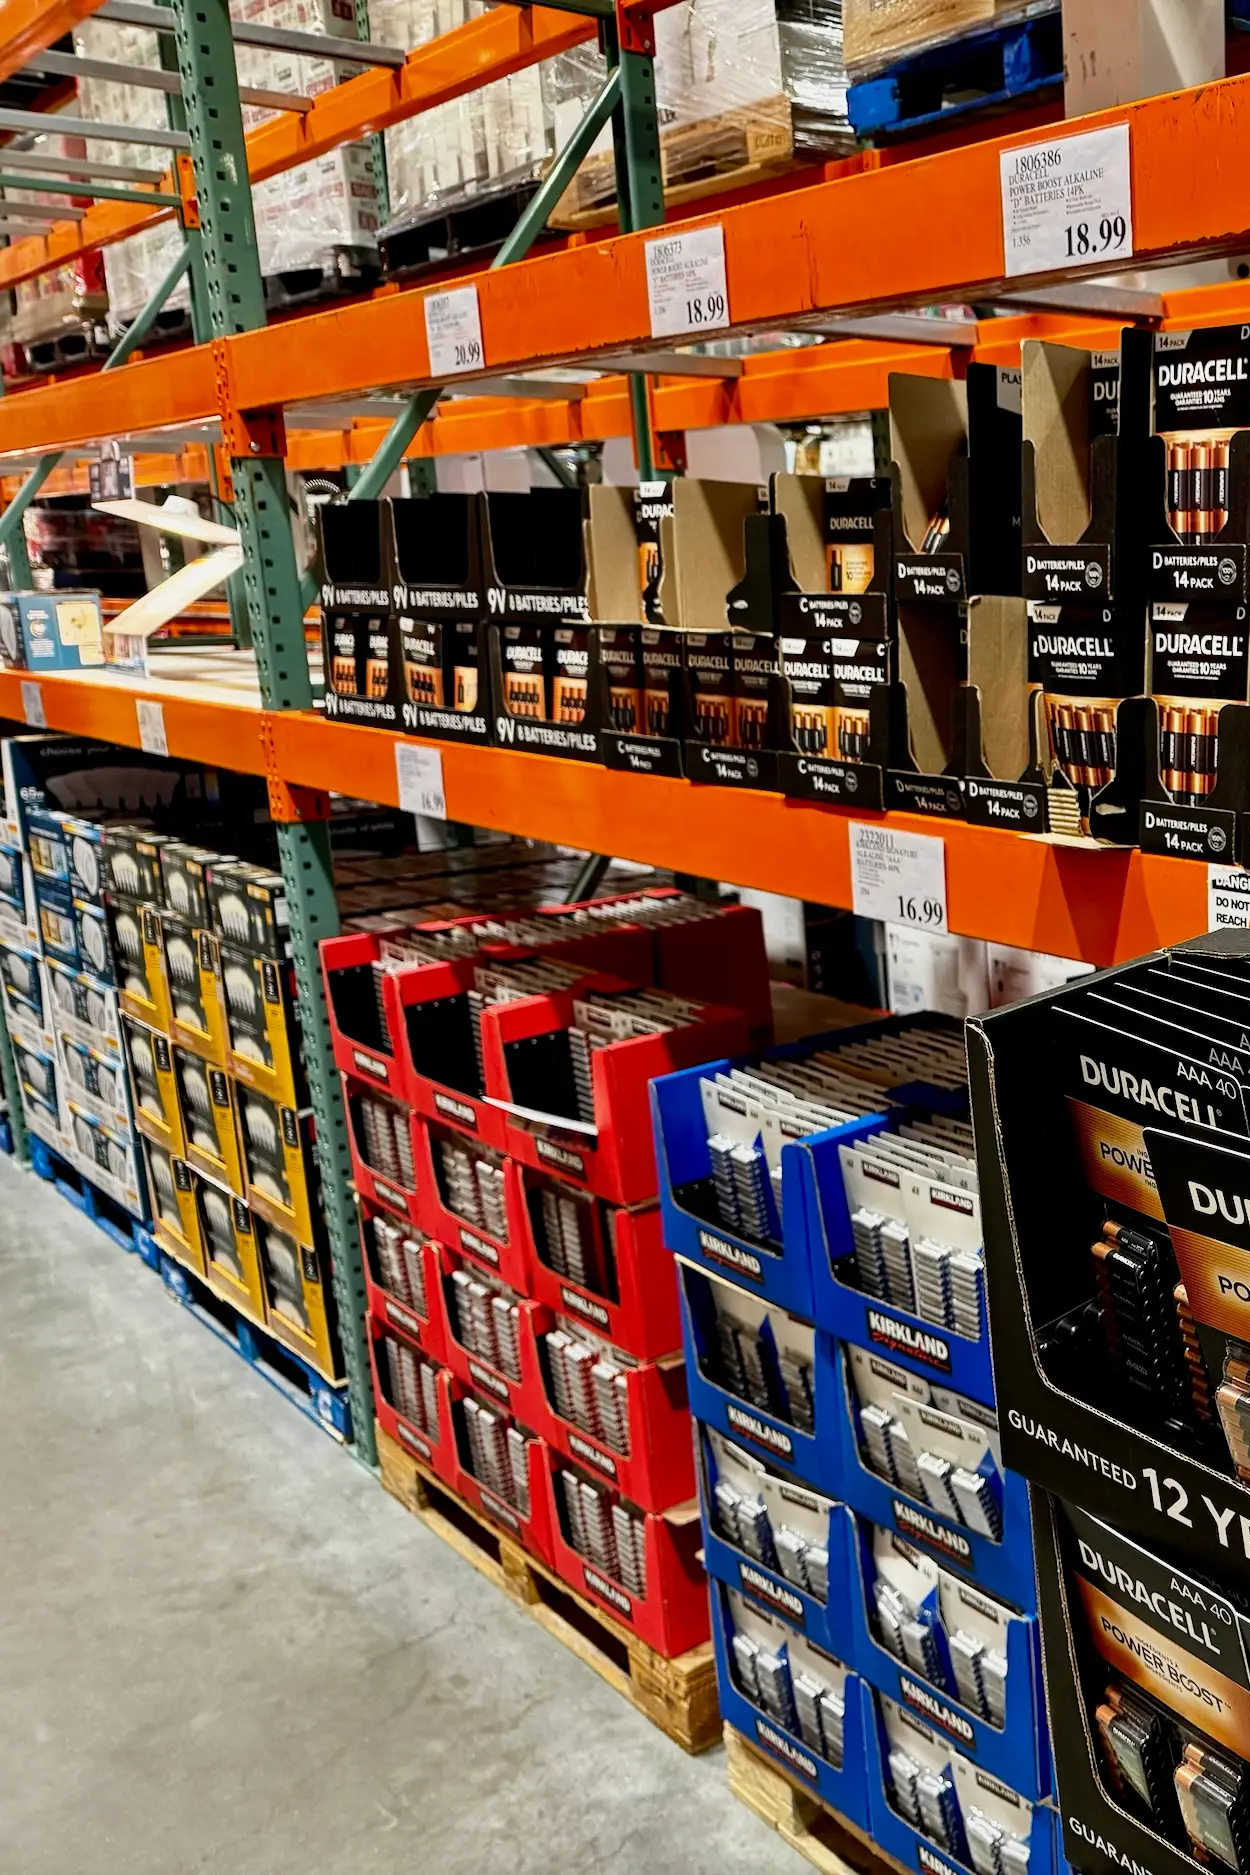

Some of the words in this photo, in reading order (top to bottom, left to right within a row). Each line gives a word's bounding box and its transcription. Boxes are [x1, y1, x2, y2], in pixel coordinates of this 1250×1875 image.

[1015, 148, 1062, 175] 1806386
[1009, 168, 1050, 186] DURACELL
[1009, 180, 1037, 198] POWER
[1038, 176, 1063, 192] BOOST
[1064, 167, 1104, 186] ALKALINE
[1024, 188, 1065, 206] BATTERIES
[1067, 184, 1085, 197] 14PK
[1065, 216, 1127, 257] 18.99
[686, 295, 725, 325] 18.99
[1158, 357, 1247, 387] DURACELL
[1155, 633, 1243, 658] DURACELL
[834, 662, 883, 683] DURACELL
[497, 717, 515, 745] 9V
[525, 726, 598, 753] BATTERIES/PILES
[898, 895, 943, 926] 16.99
[1216, 896, 1230, 908] DO
[1231, 900, 1250, 912] NOT
[1216, 913, 1247, 927] REACH
[930, 1188, 974, 1211] KIRKLAND
[700, 1230, 761, 1275] KIRKLAND
[869, 1311, 949, 1361] KIRKLAND
[727, 1405, 792, 1453] KIRKLAND
[1007, 1408, 1137, 1491] GUARANTEED
[1141, 1467, 1193, 1528] 12
[894, 1500, 970, 1556] KIRKLAND
[1079, 1539, 1221, 1656] DURACELL
